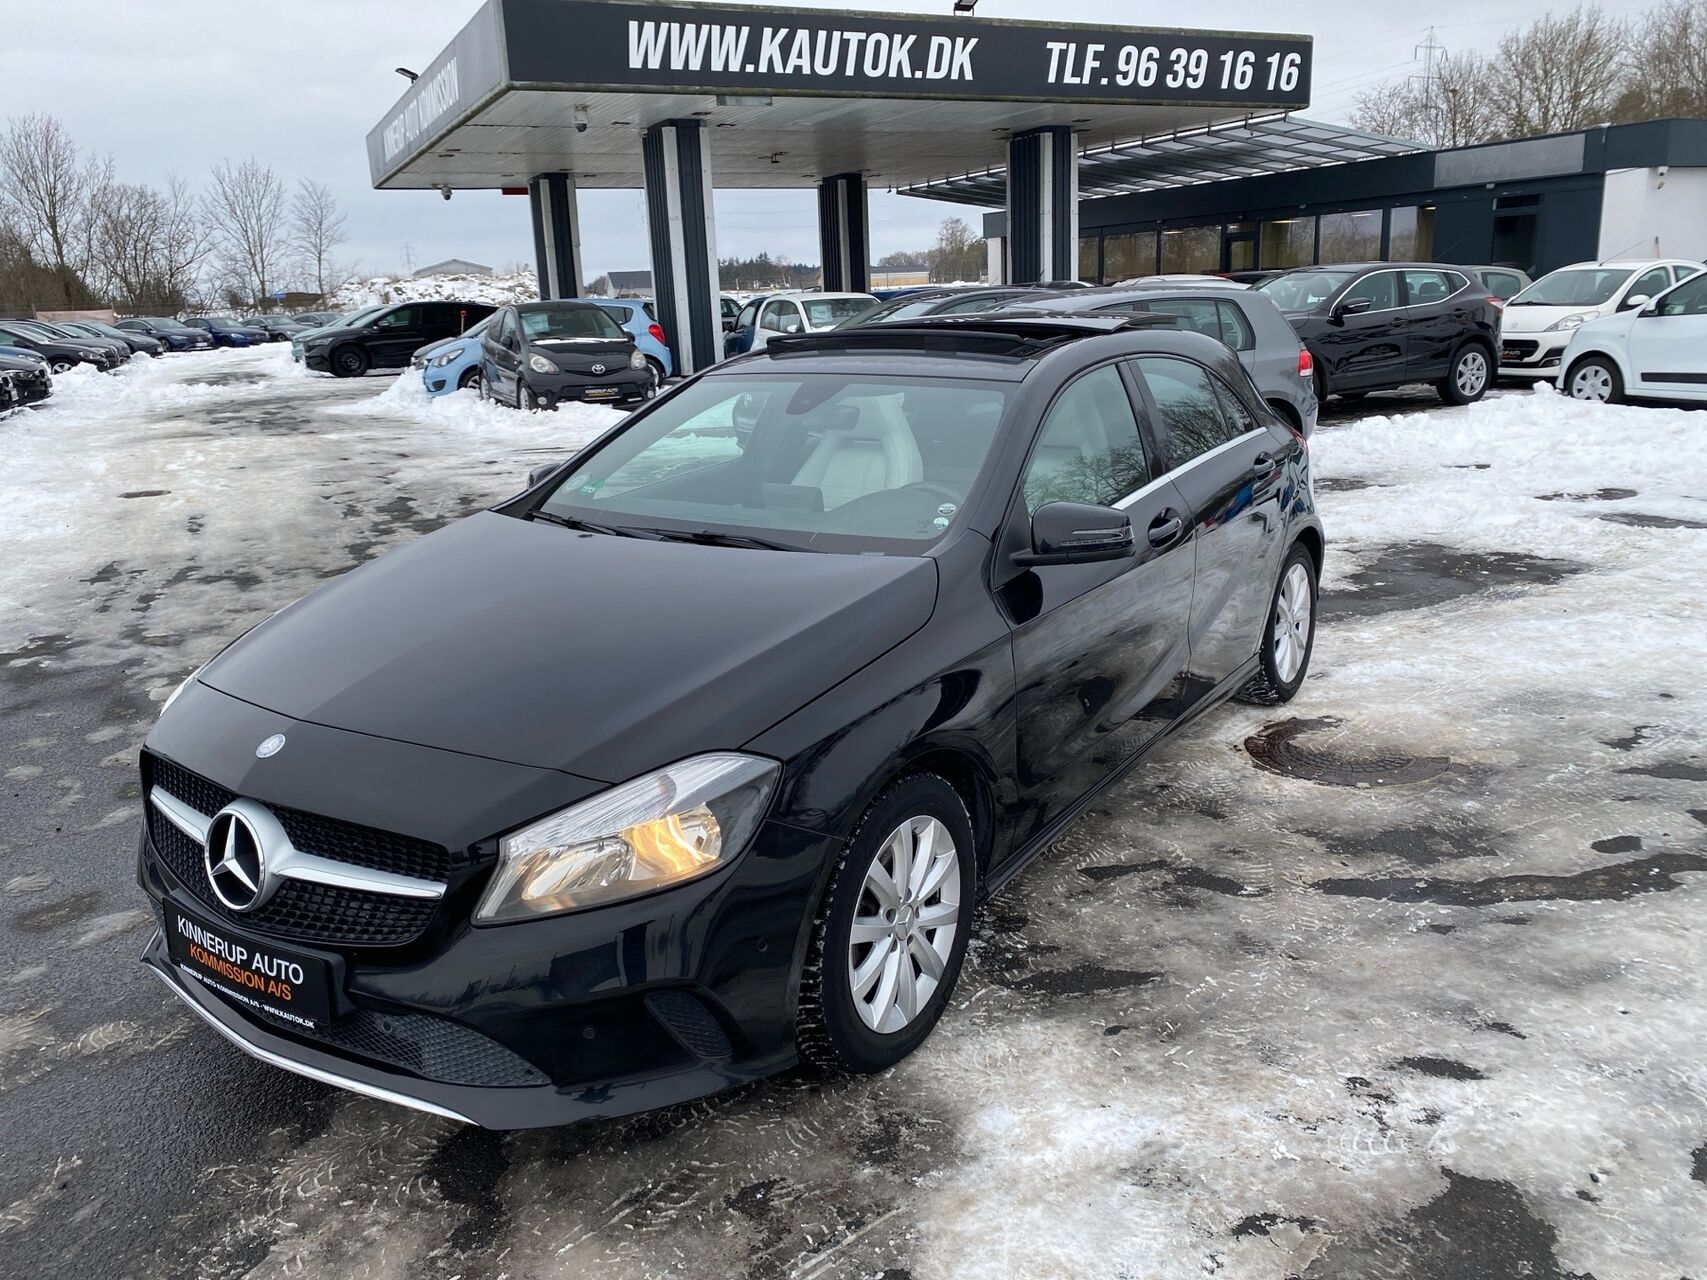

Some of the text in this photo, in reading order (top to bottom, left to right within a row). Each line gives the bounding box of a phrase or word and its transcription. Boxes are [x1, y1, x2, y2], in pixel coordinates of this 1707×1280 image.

[628, 20, 979, 81] WWW.KAUTOK.DK
[1046, 41, 1302, 92] TLF. 96 39 16 16
[177, 914, 304, 985] KINNERUP AUTO
[189, 943, 292, 1002] KOMMISSION A/S
